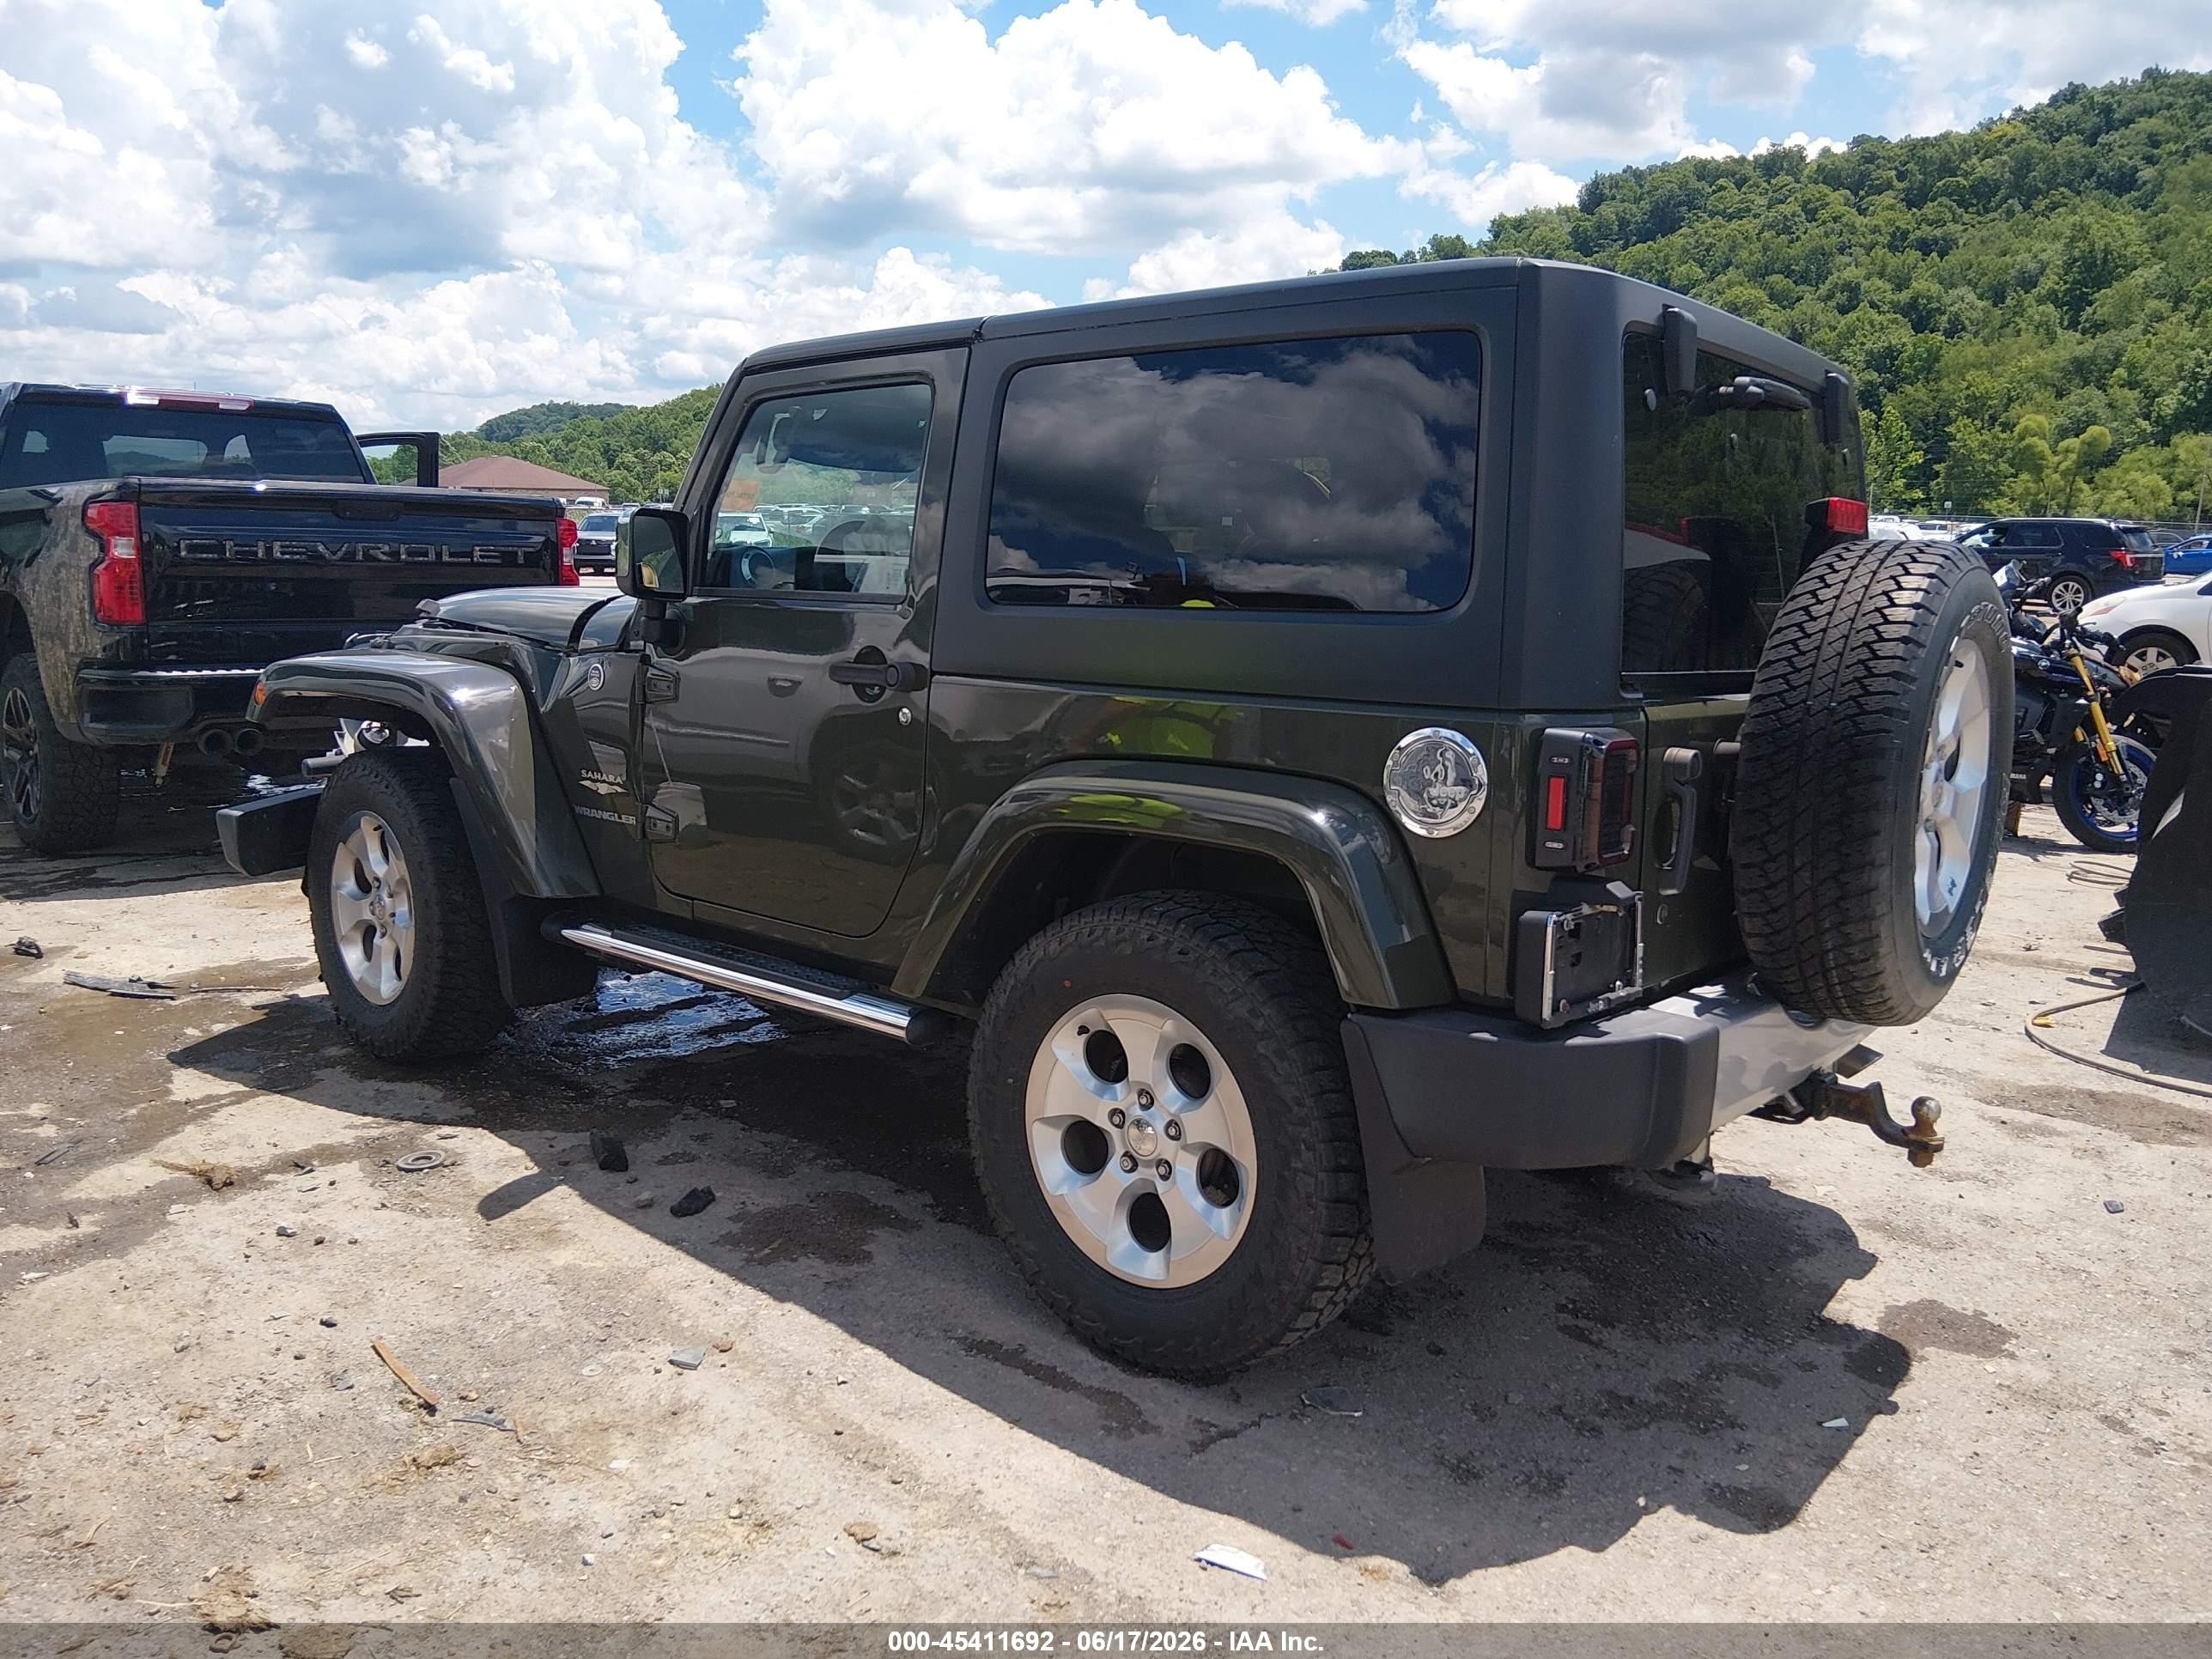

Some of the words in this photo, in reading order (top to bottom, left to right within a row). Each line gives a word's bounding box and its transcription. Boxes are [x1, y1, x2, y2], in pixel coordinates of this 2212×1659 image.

[179, 538, 536, 564] CHEVROLET
[580, 769, 624, 785] SAHARA
[574, 805, 636, 825] WRANGLER
